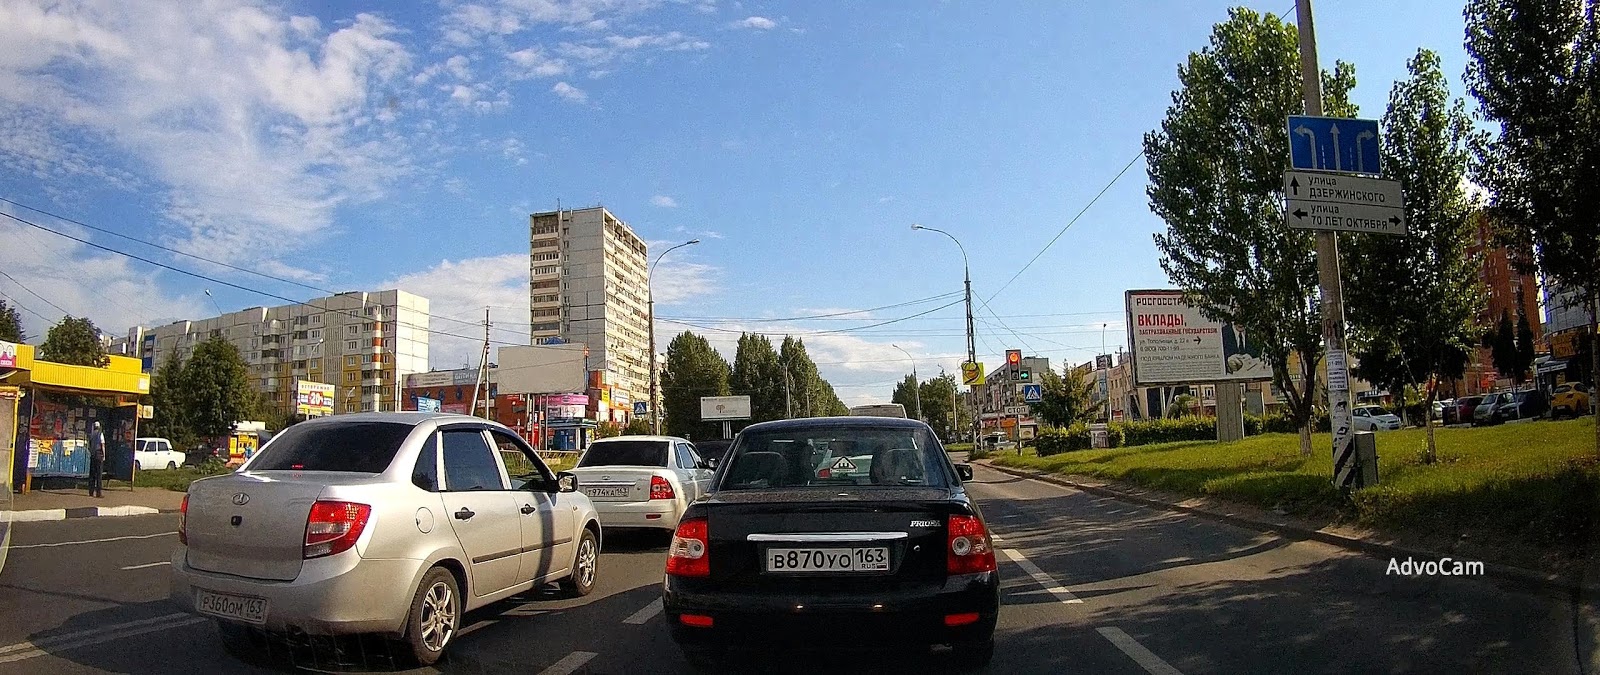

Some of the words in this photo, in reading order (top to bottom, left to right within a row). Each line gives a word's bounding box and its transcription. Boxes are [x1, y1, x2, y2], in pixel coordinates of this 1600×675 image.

[1308, 176, 1337, 186] улица
[1309, 187, 1385, 203] ДЗЕРЖИНСКОГО
[1310, 204, 1340, 214] улица
[1311, 215, 1321, 225] 70
[1325, 216, 1344, 227] ЛЕТ
[1346, 217, 1388, 230] ОКТЯБРЯ
[1137, 313, 1187, 327] ВКЛАДЫ,
[1007, 406, 1026, 414] СТОП
[774, 550, 851, 569] В870УО
[855, 548, 884, 563] 163
[245, 600, 262, 614] 163
